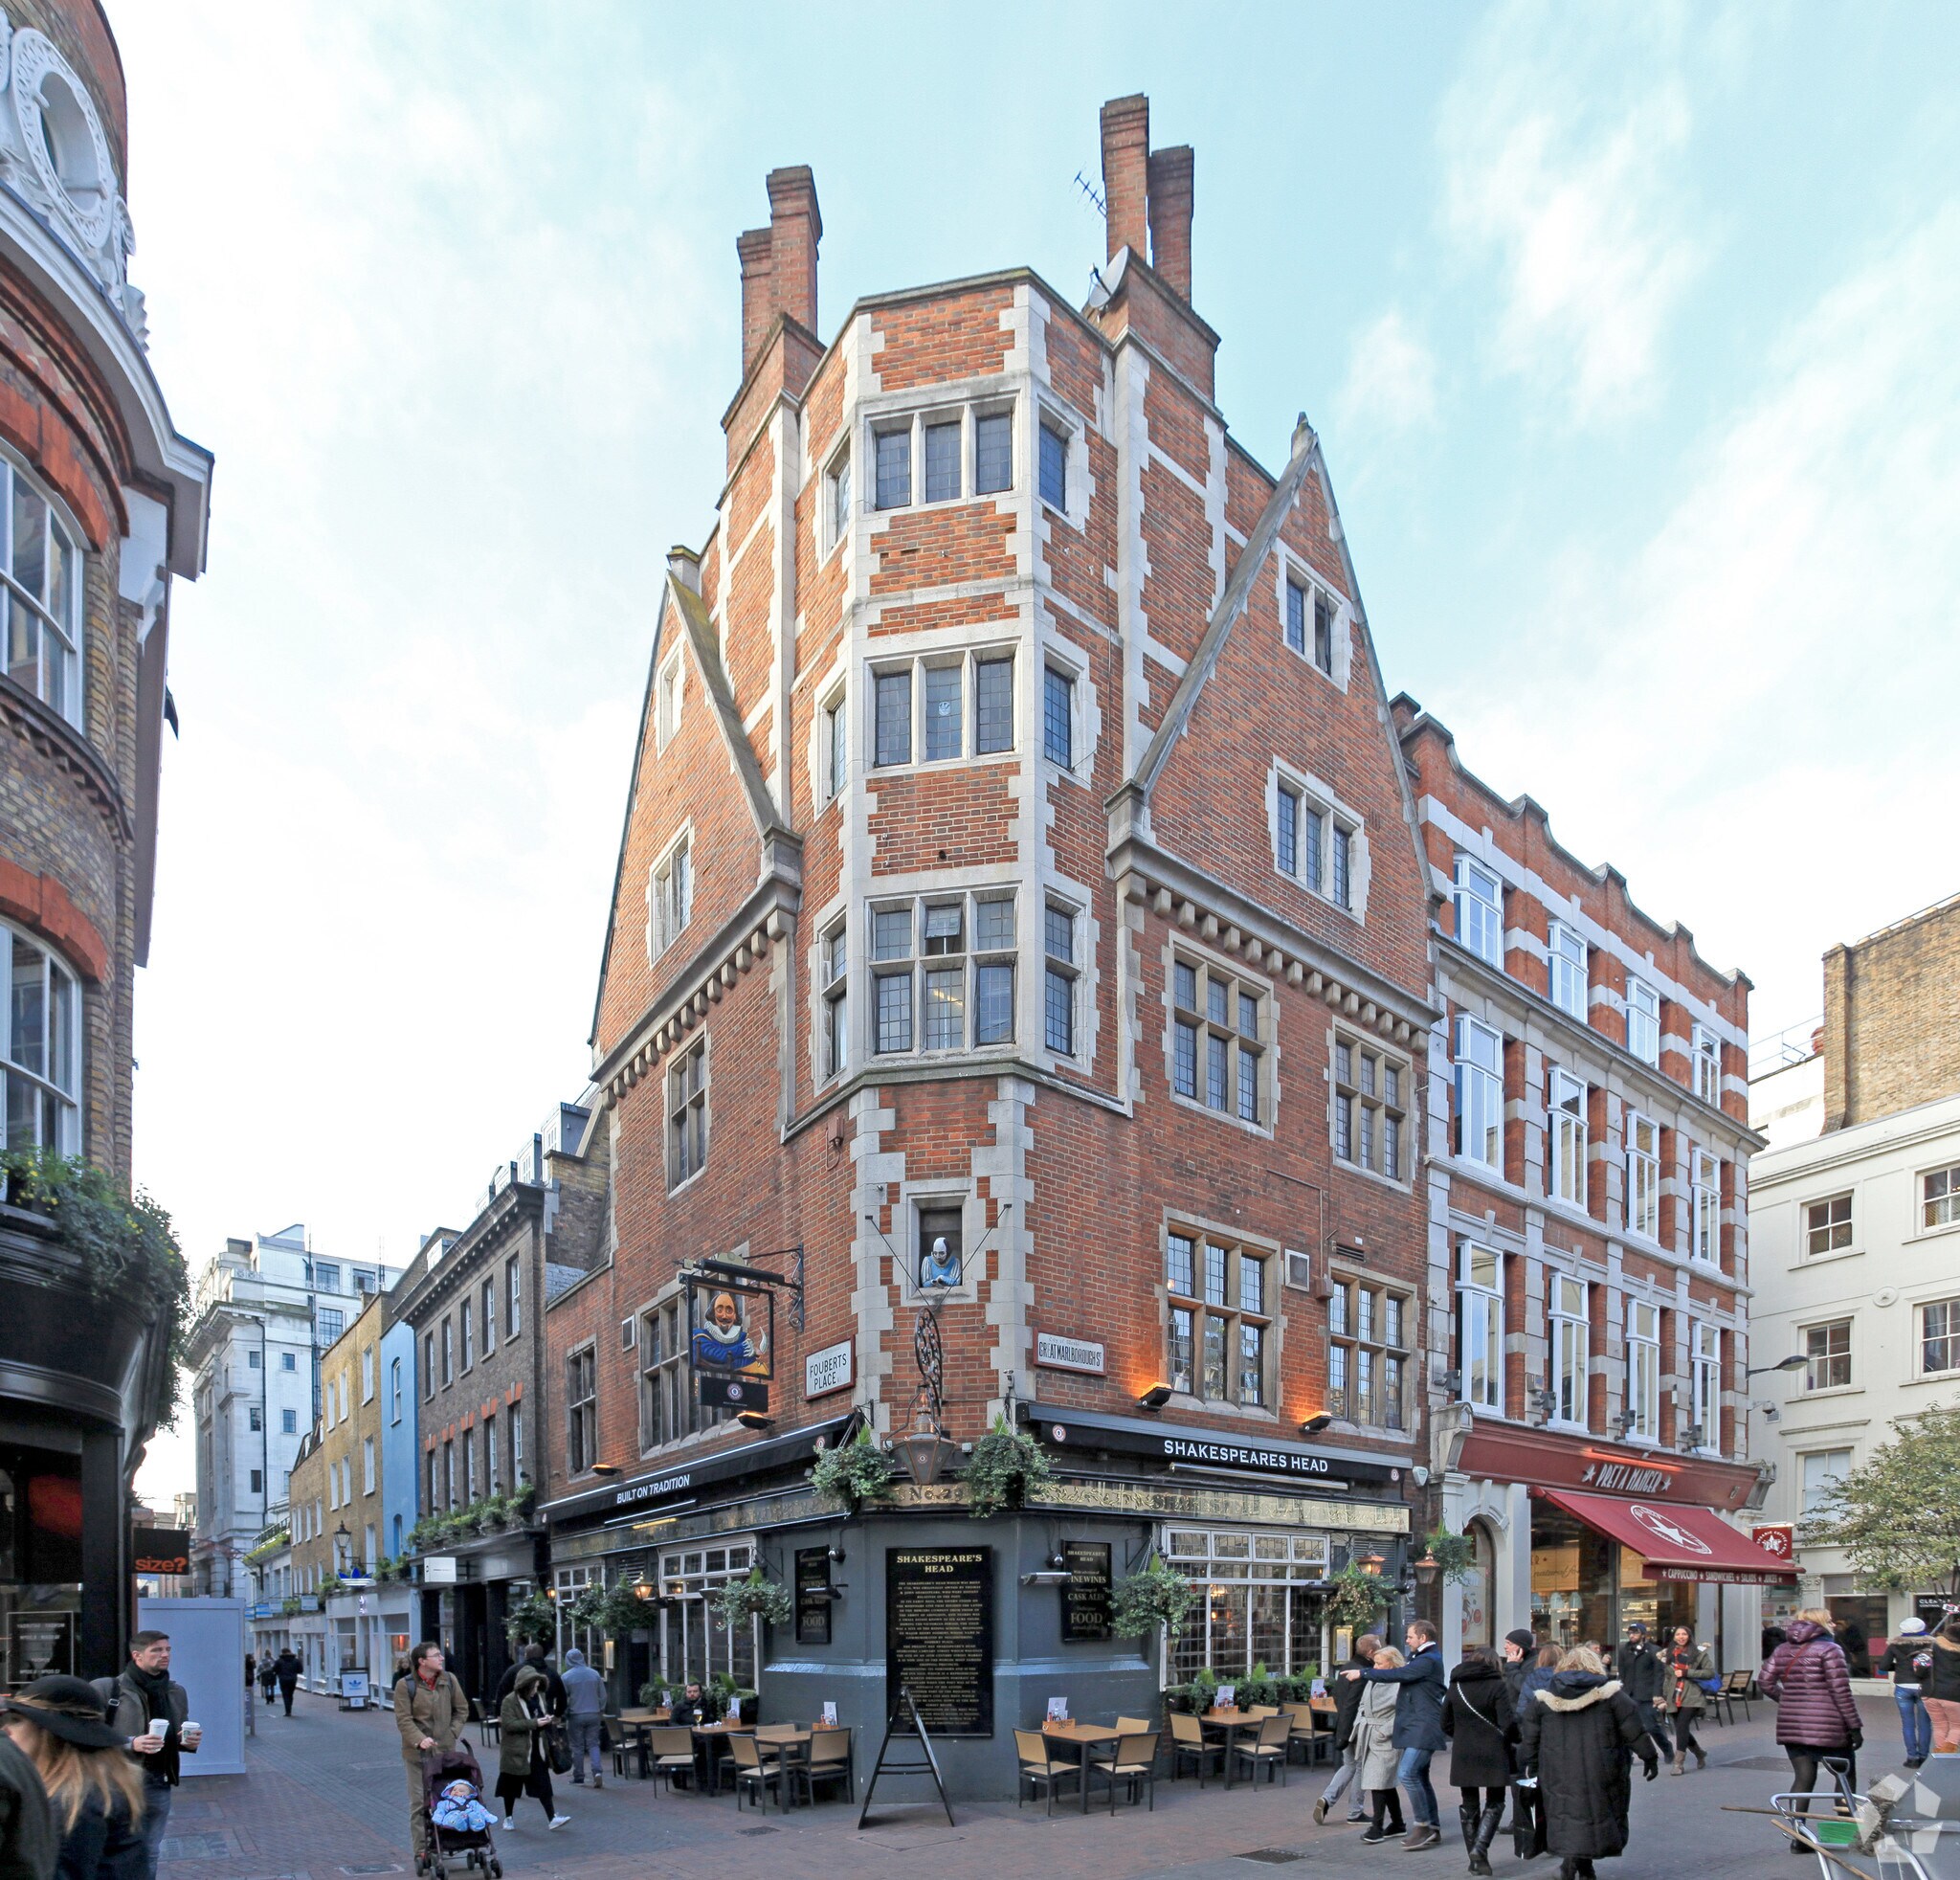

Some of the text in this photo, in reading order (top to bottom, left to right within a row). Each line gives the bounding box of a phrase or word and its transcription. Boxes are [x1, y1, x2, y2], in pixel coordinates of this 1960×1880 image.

[1039, 1341, 1057, 1359] GREAT
[1057, 1344, 1096, 1366] MARLBOROUGH
[810, 1354, 847, 1377] FOUBERTS
[813, 1372, 836, 1391] PLACE
[1164, 1440, 1328, 1472] SHAKESPEARES HEAD
[1594, 1463, 1662, 1492] PRET A MANGER
[616, 1474, 690, 1504] BUILT ON TRADITION
[135, 1555, 187, 1573] size?
[897, 1554, 983, 1563] SHAKESPEARE'S
[1668, 1568, 1698, 1580] CAPPUCCINO
[1705, 1571, 1735, 1581] SANDWICHES
[1067, 1593, 1105, 1601] CASK ALES
[802, 1616, 826, 1627] FOOD
[1071, 1612, 1103, 1623] FOOD
